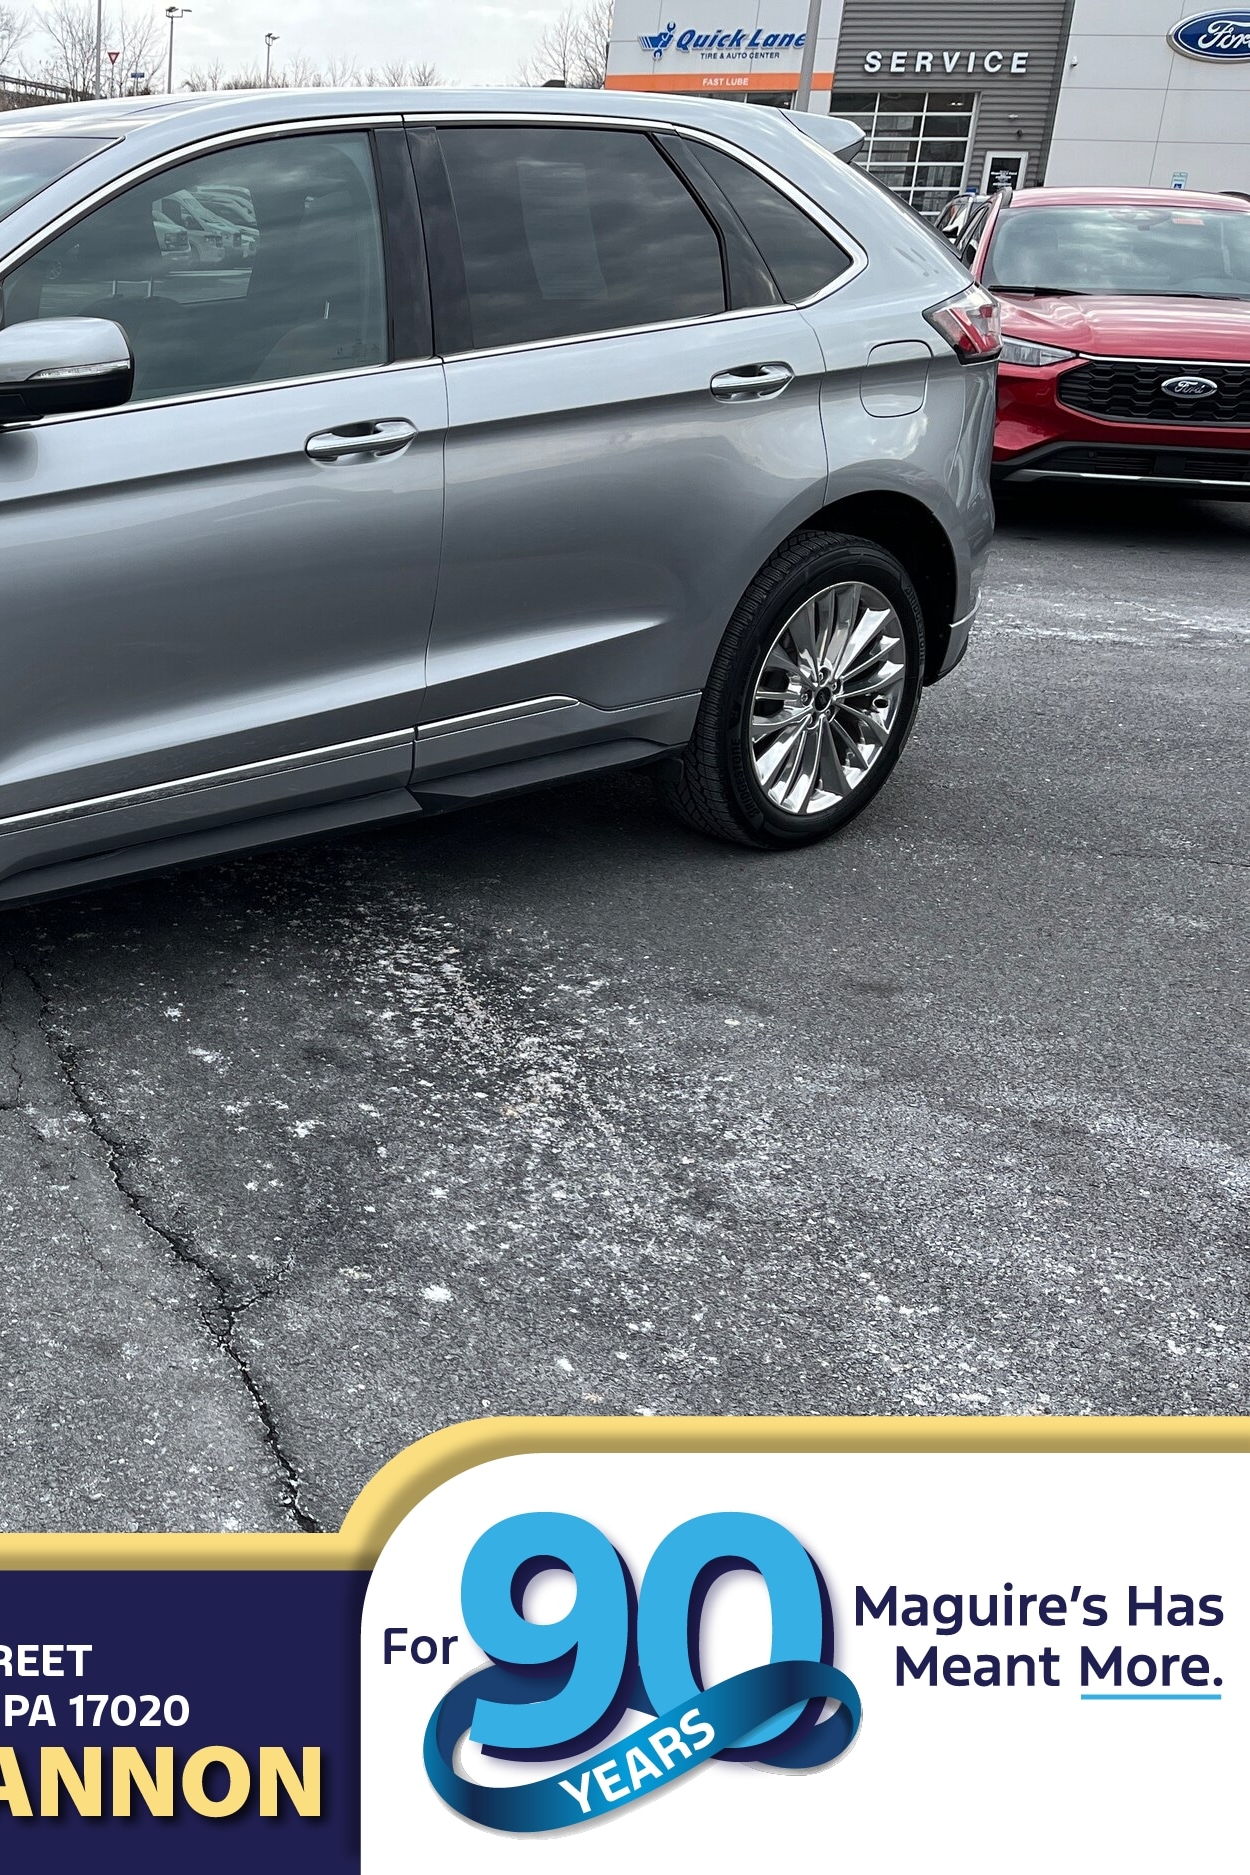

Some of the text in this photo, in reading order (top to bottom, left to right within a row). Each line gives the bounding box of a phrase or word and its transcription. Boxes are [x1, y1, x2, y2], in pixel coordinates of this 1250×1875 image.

[676, 28, 807, 52] Quick Lane
[1198, 20, 1250, 49] For
[863, 51, 1029, 74] SERVICE
[702, 77, 749, 86] FAST LUBE
[1174, 380, 1206, 394] Ford
